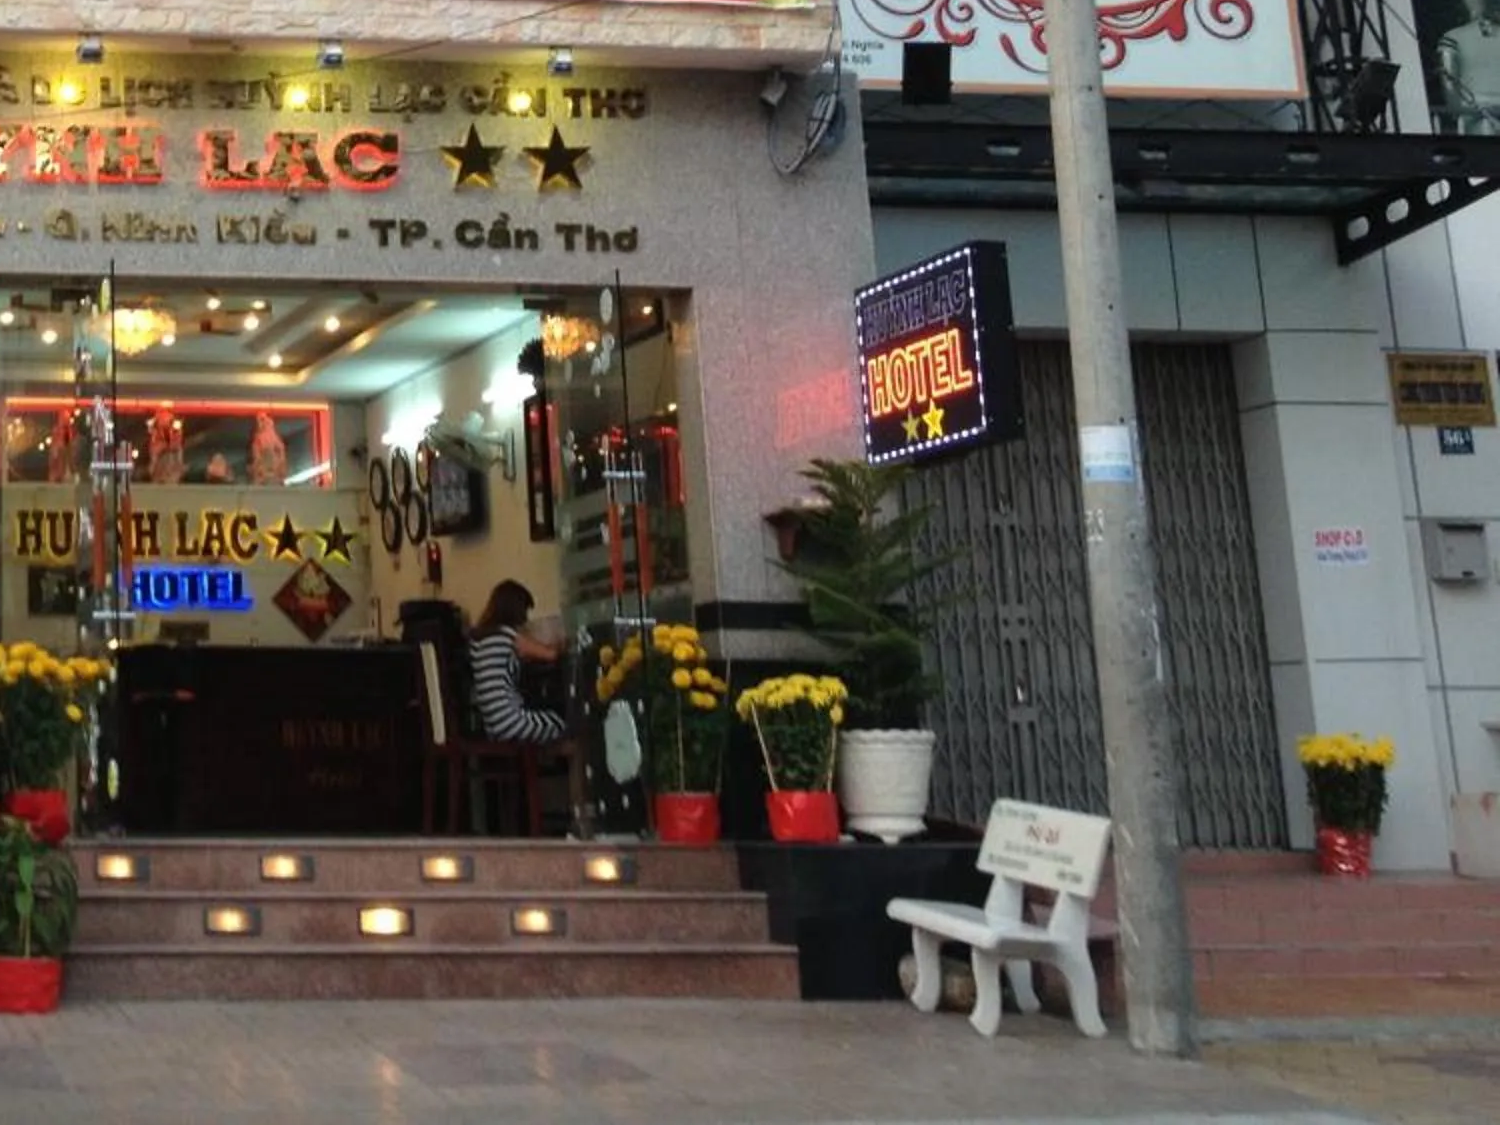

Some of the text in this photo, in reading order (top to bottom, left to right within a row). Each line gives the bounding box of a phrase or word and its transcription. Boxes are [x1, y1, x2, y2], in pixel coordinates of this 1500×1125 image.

[369, 219, 442, 249] TP.
[455, 212, 540, 250] Cần
[555, 225, 639, 253] Thơ
[868, 328, 974, 418] HOTEL
[128, 568, 255, 613] HOTEL
